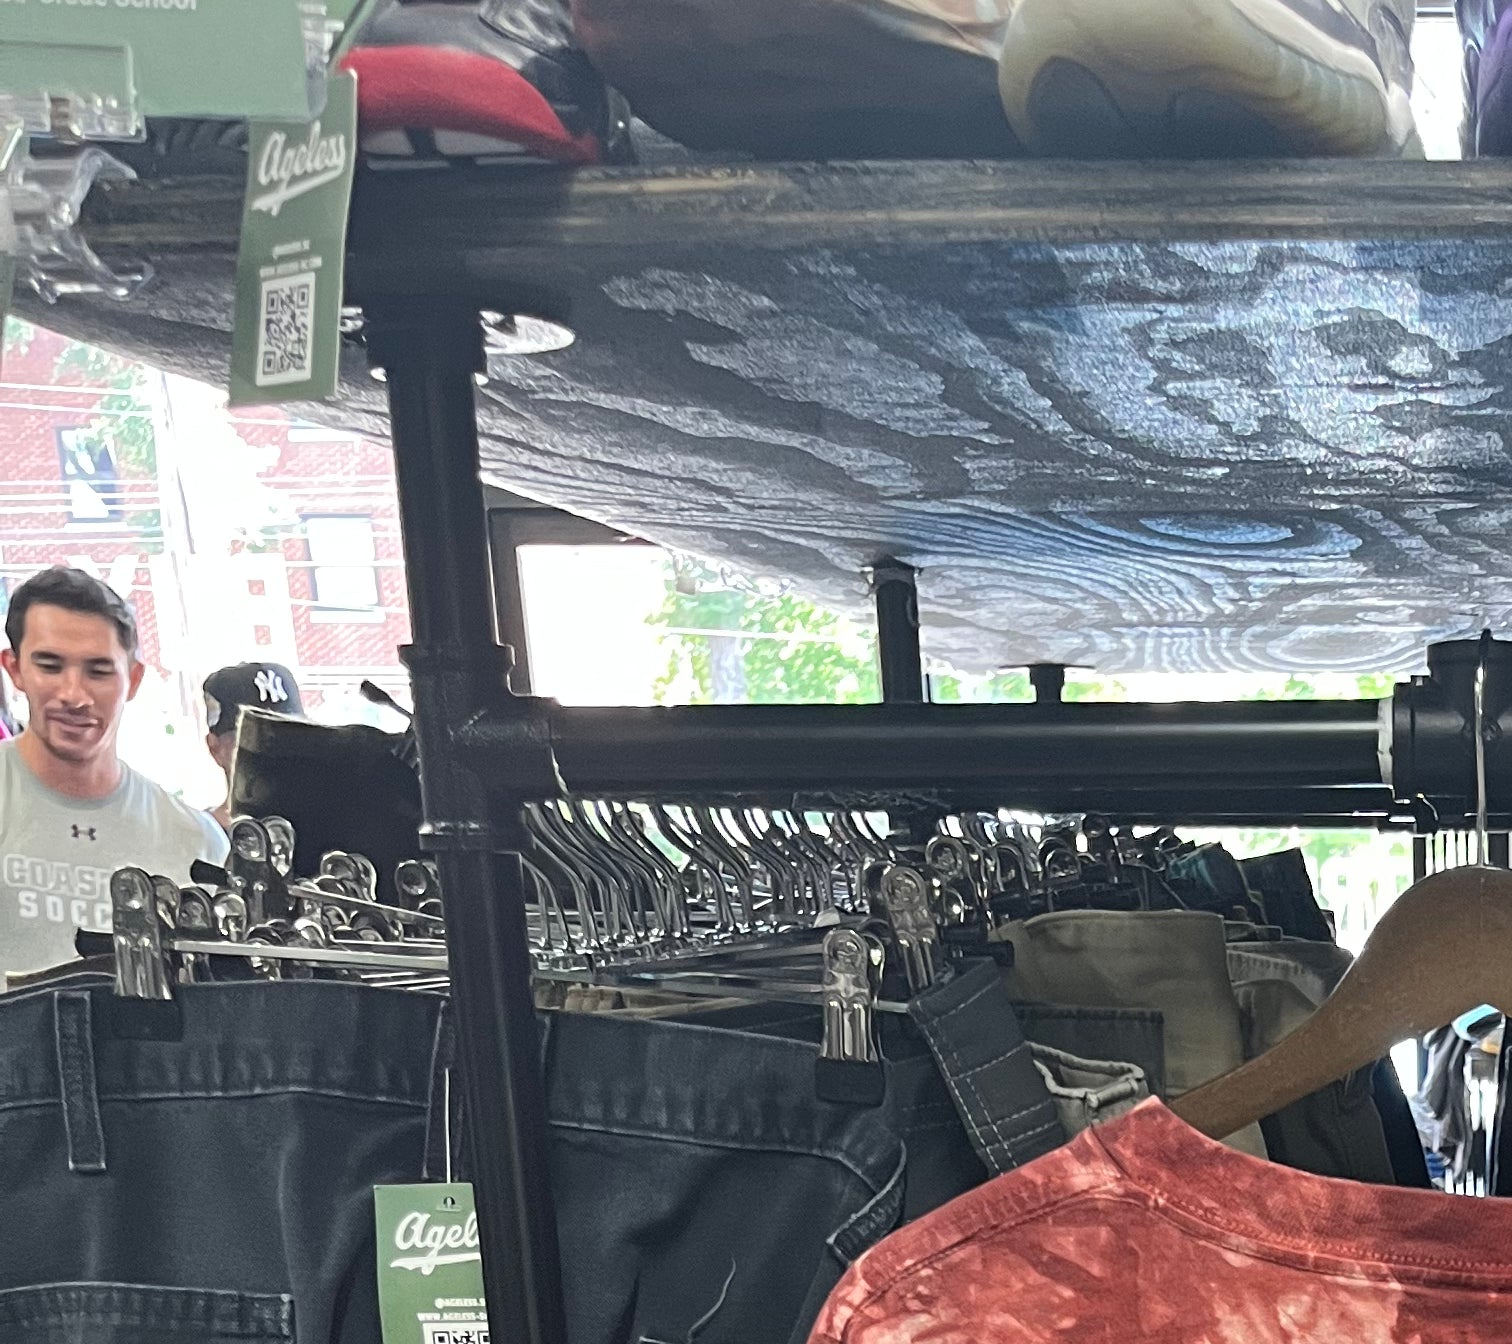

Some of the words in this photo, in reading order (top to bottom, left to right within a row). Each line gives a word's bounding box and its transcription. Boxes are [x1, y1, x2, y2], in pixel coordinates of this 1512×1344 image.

[256, 119, 346, 216] Ageless
[3, 853, 113, 900] COAST
[18, 890, 113, 929] SOCC
[393, 1211, 482, 1276] Agel
